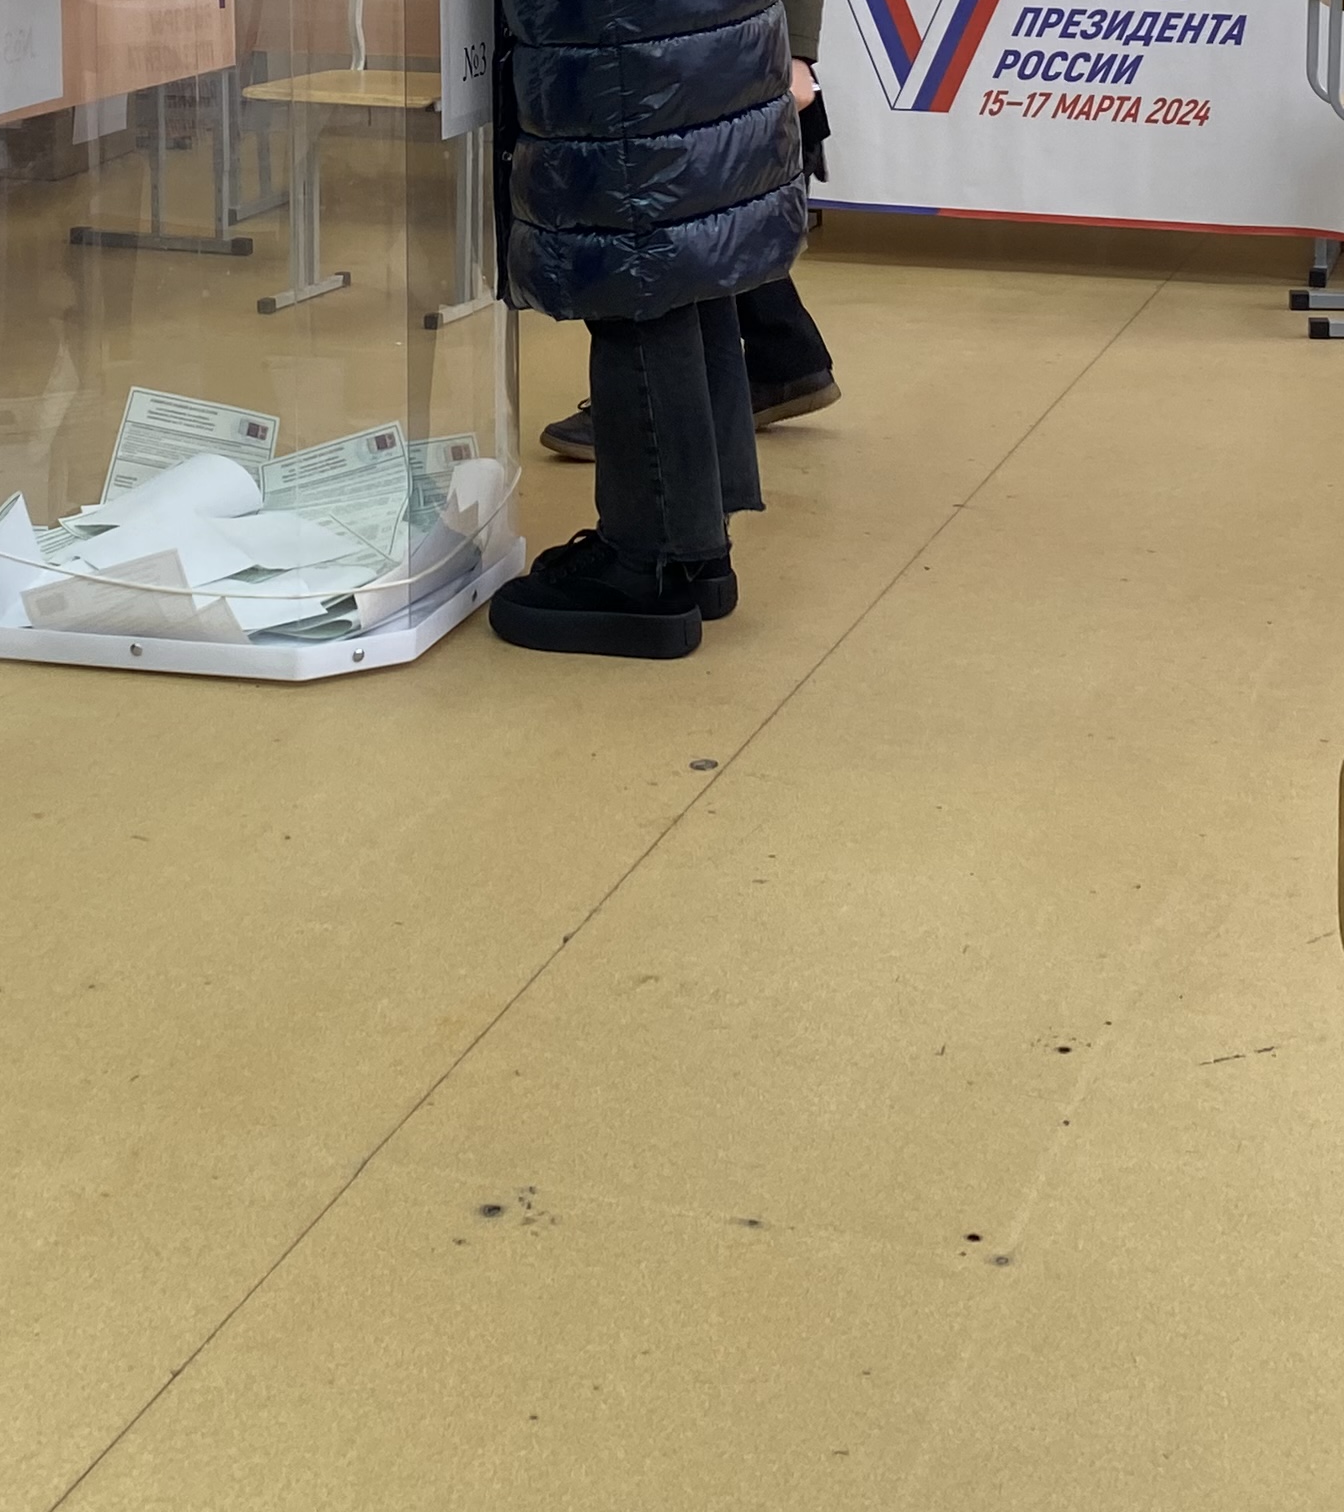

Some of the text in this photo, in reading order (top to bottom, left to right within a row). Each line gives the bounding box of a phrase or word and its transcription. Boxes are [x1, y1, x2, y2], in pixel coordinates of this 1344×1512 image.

[1011, 6, 1248, 47] ПРЕЗИДЕНТА
[463, 42, 487, 81] №3
[992, 49, 1144, 85] РОССИИ
[1051, 92, 1142, 123] МАРТА
[1145, 97, 1211, 127] 2024
